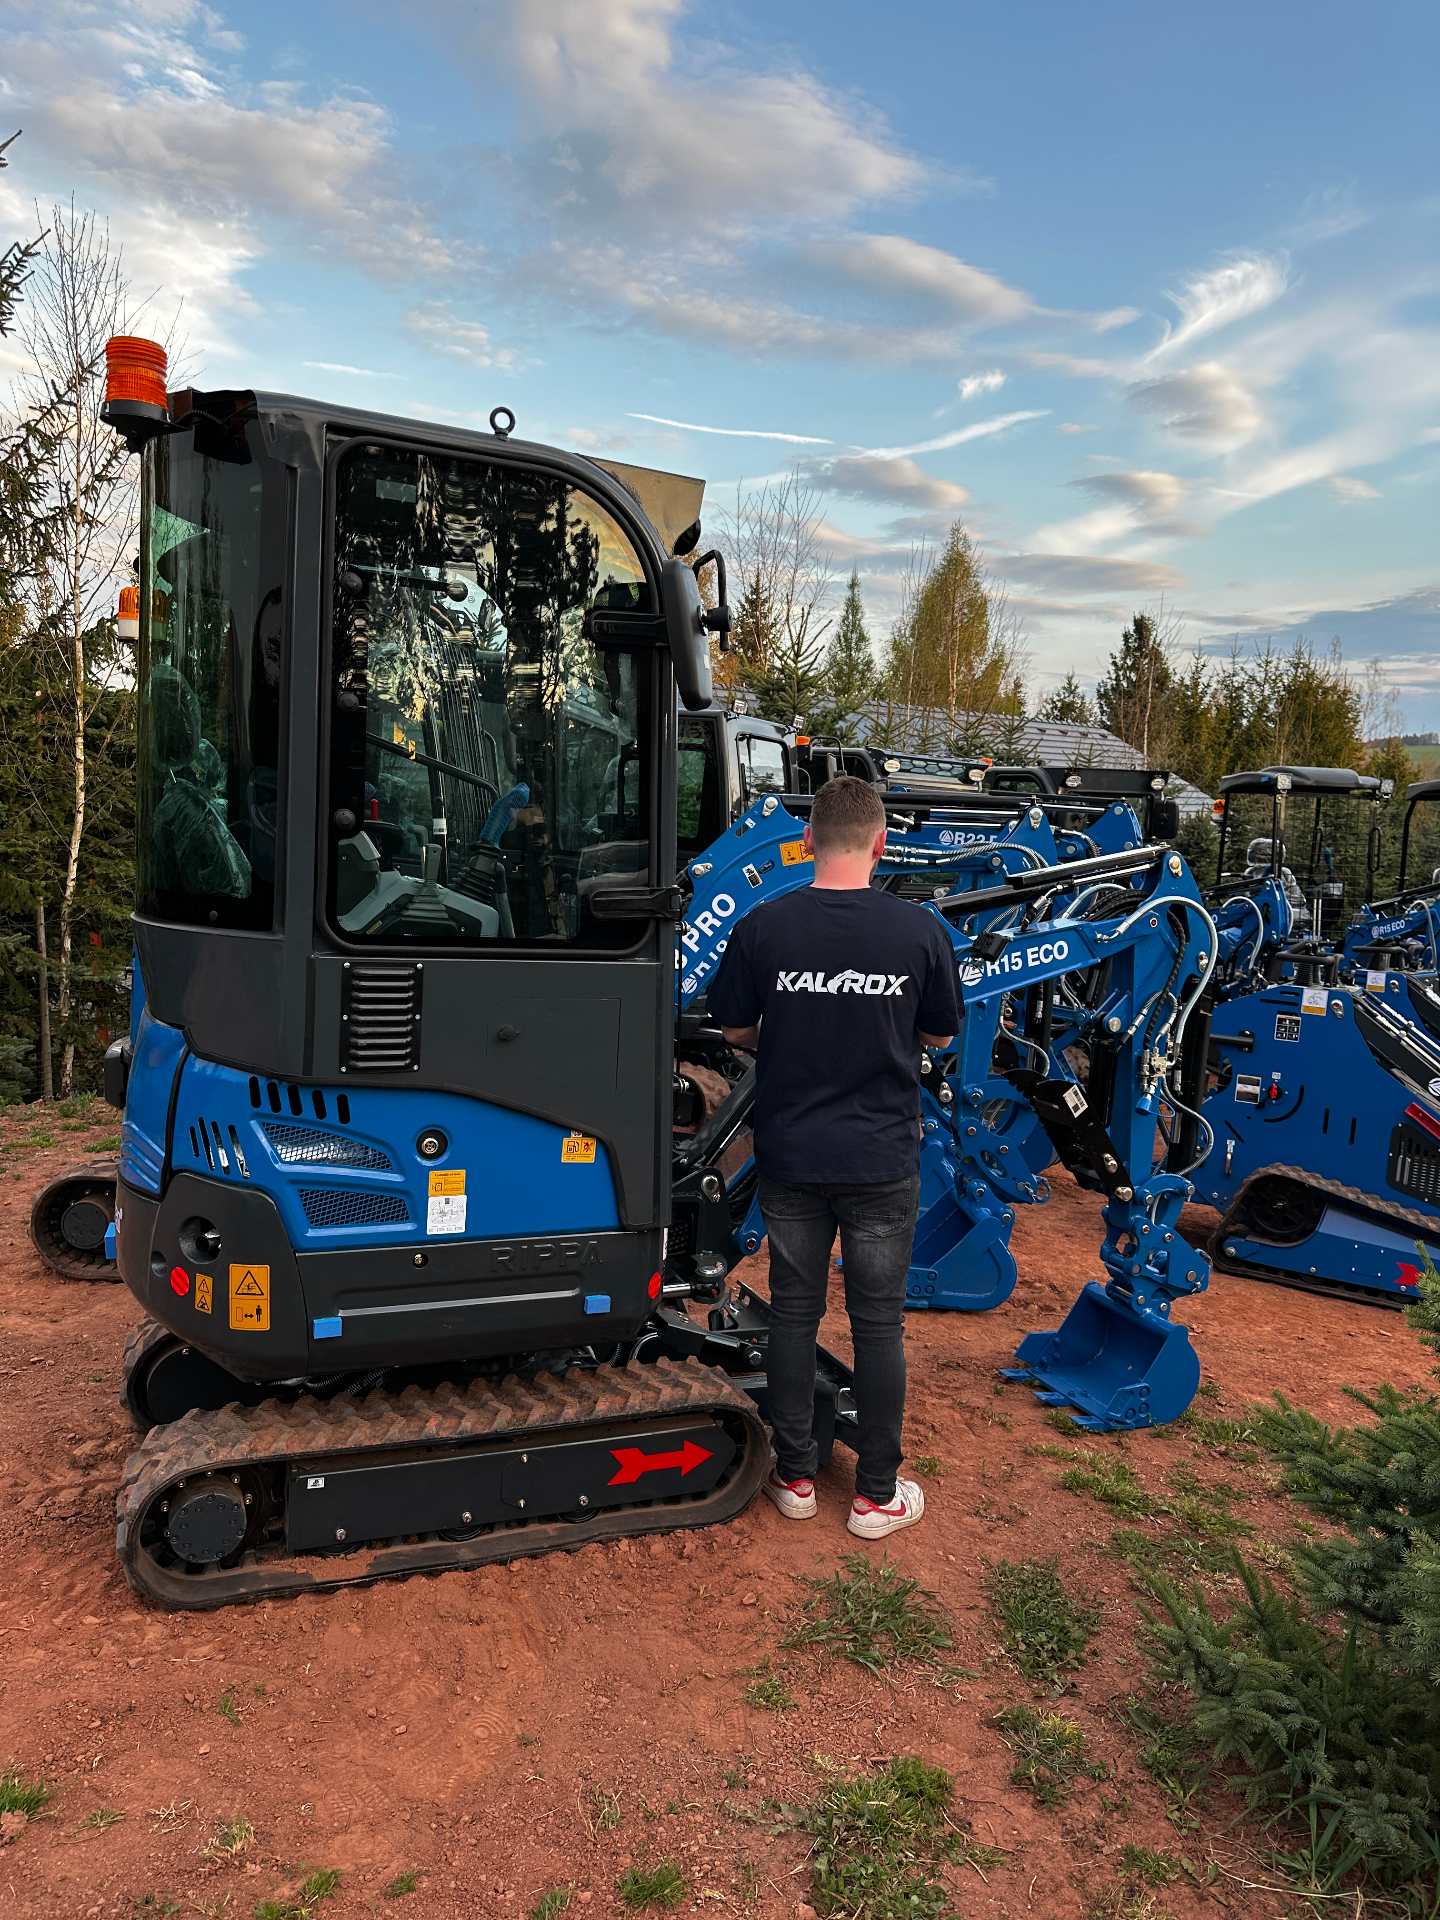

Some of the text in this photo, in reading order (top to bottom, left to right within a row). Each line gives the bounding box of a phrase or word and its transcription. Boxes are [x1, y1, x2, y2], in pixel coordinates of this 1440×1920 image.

[681, 893, 736, 953] PRO
[1380, 919, 1405, 935] R15 ECO
[985, 940, 1069, 977] R15 ECO
[488, 1240, 606, 1273] RIPPA
